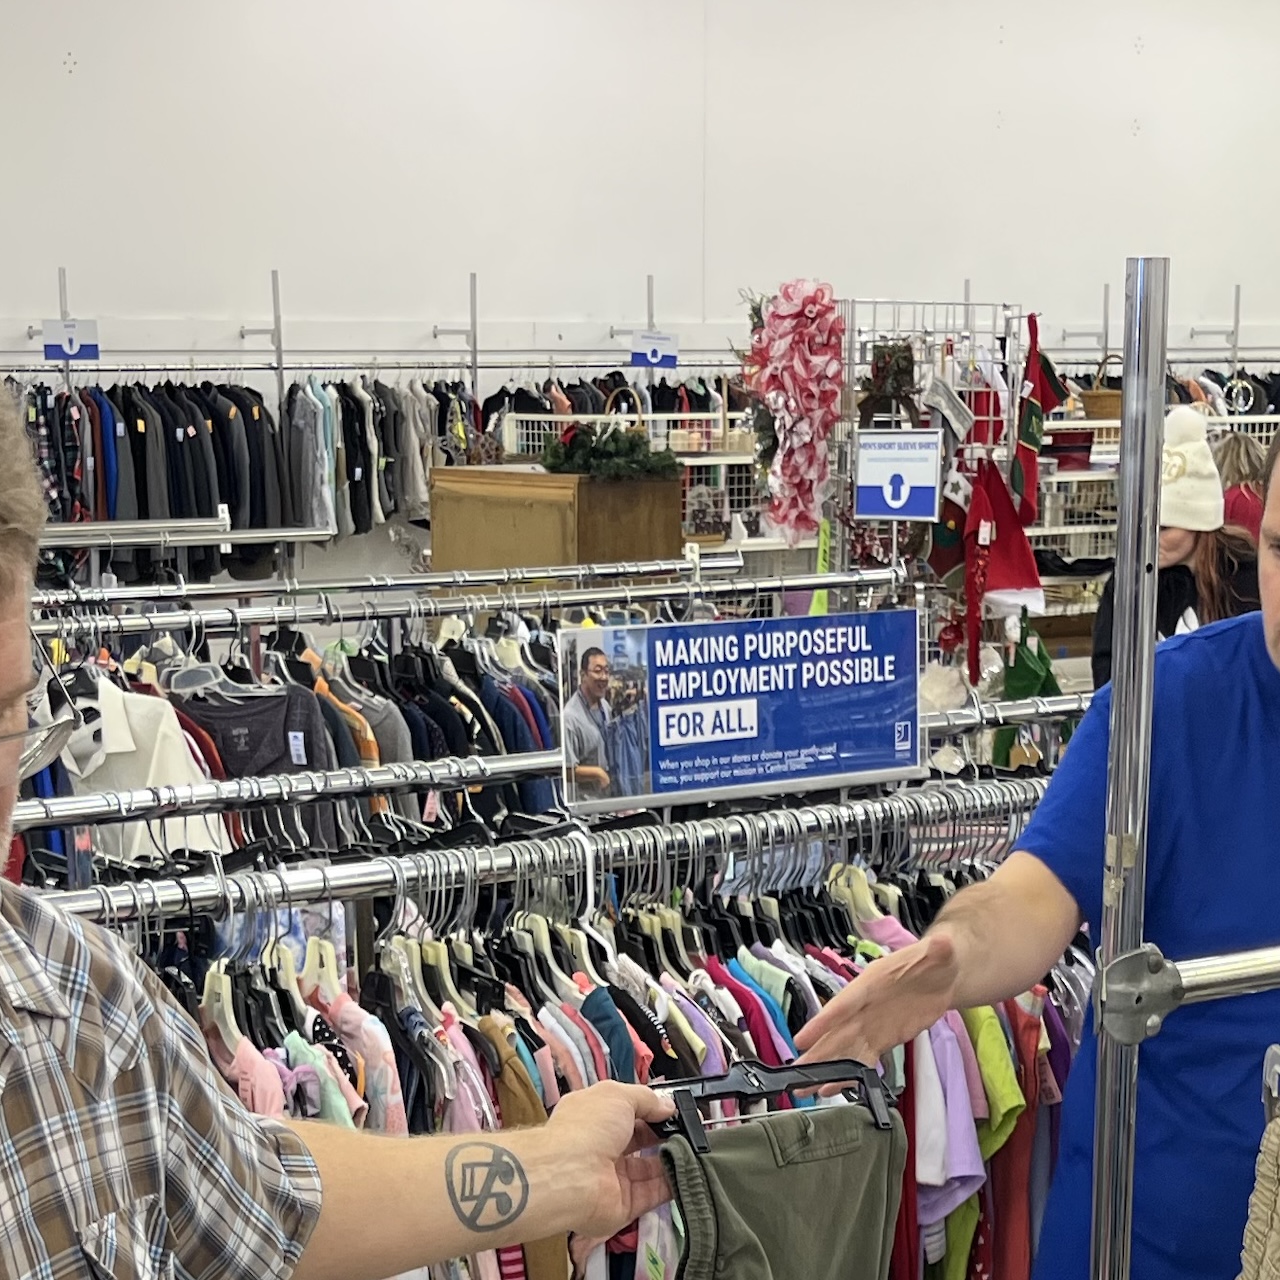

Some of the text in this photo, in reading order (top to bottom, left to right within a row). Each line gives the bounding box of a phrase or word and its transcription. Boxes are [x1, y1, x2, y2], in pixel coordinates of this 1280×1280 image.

[878, 442, 897, 450] SHORT
[897, 442, 917, 451] SLEEVE
[918, 441, 938, 450] SHIRTS
[654, 634, 739, 668] MAKING
[743, 625, 872, 661] PURPOSEFUL
[656, 655, 896, 701] EMPLOYMENT POSSIBLE
[664, 708, 755, 740] FOR ALL.
[659, 758, 680, 771] When
[680, 761, 694, 773] you
[694, 756, 711, 770] shop
[732, 754, 751, 764] stores
[760, 750, 783, 761] donate
[784, 750, 800, 761] your
[679, 774, 693, 785] you
[694, 770, 720, 783] support
[733, 766, 757, 777] mission
[765, 761, 788, 774] Central
